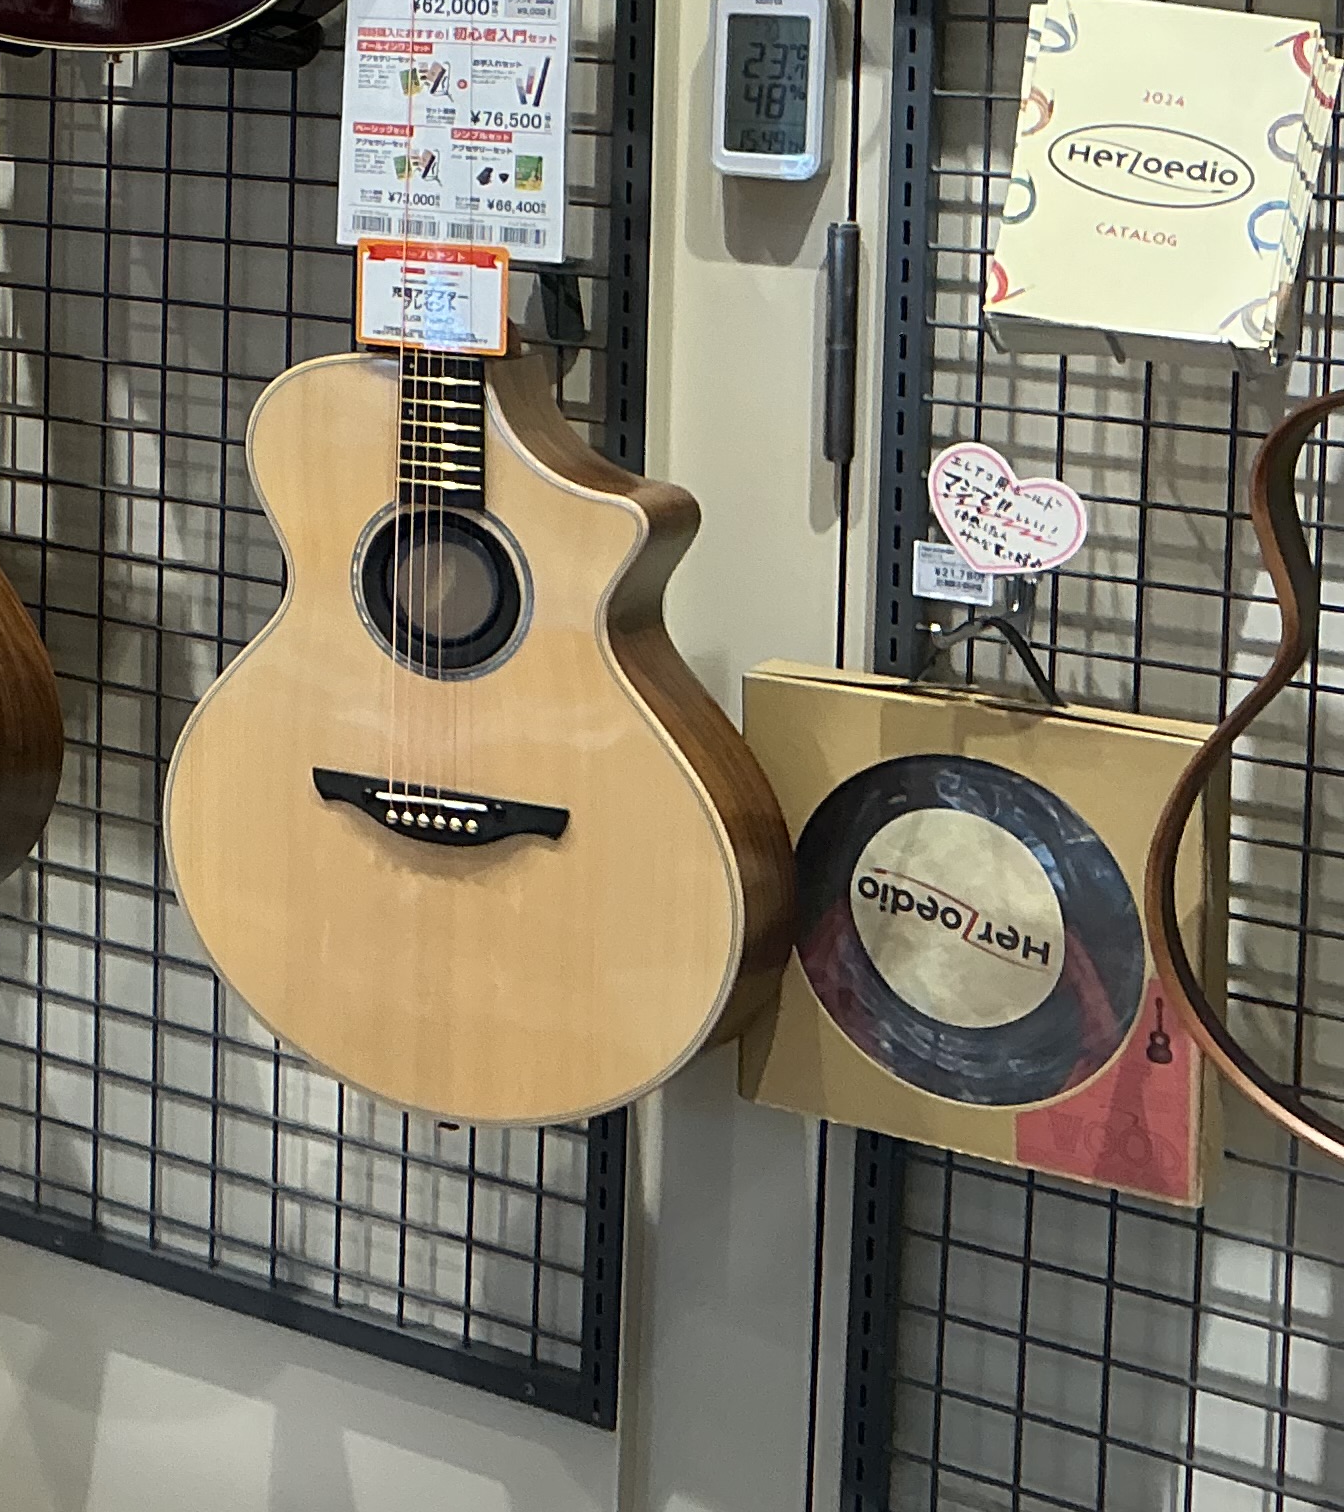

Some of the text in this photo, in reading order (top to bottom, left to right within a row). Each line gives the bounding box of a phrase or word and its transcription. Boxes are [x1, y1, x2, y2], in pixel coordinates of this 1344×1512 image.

[453, 26, 557, 43] 初心者入門セット
[1143, 89, 1185, 108] 2024
[470, 110, 543, 129] ¥76,500
[1096, 222, 1178, 247] CATALOG
